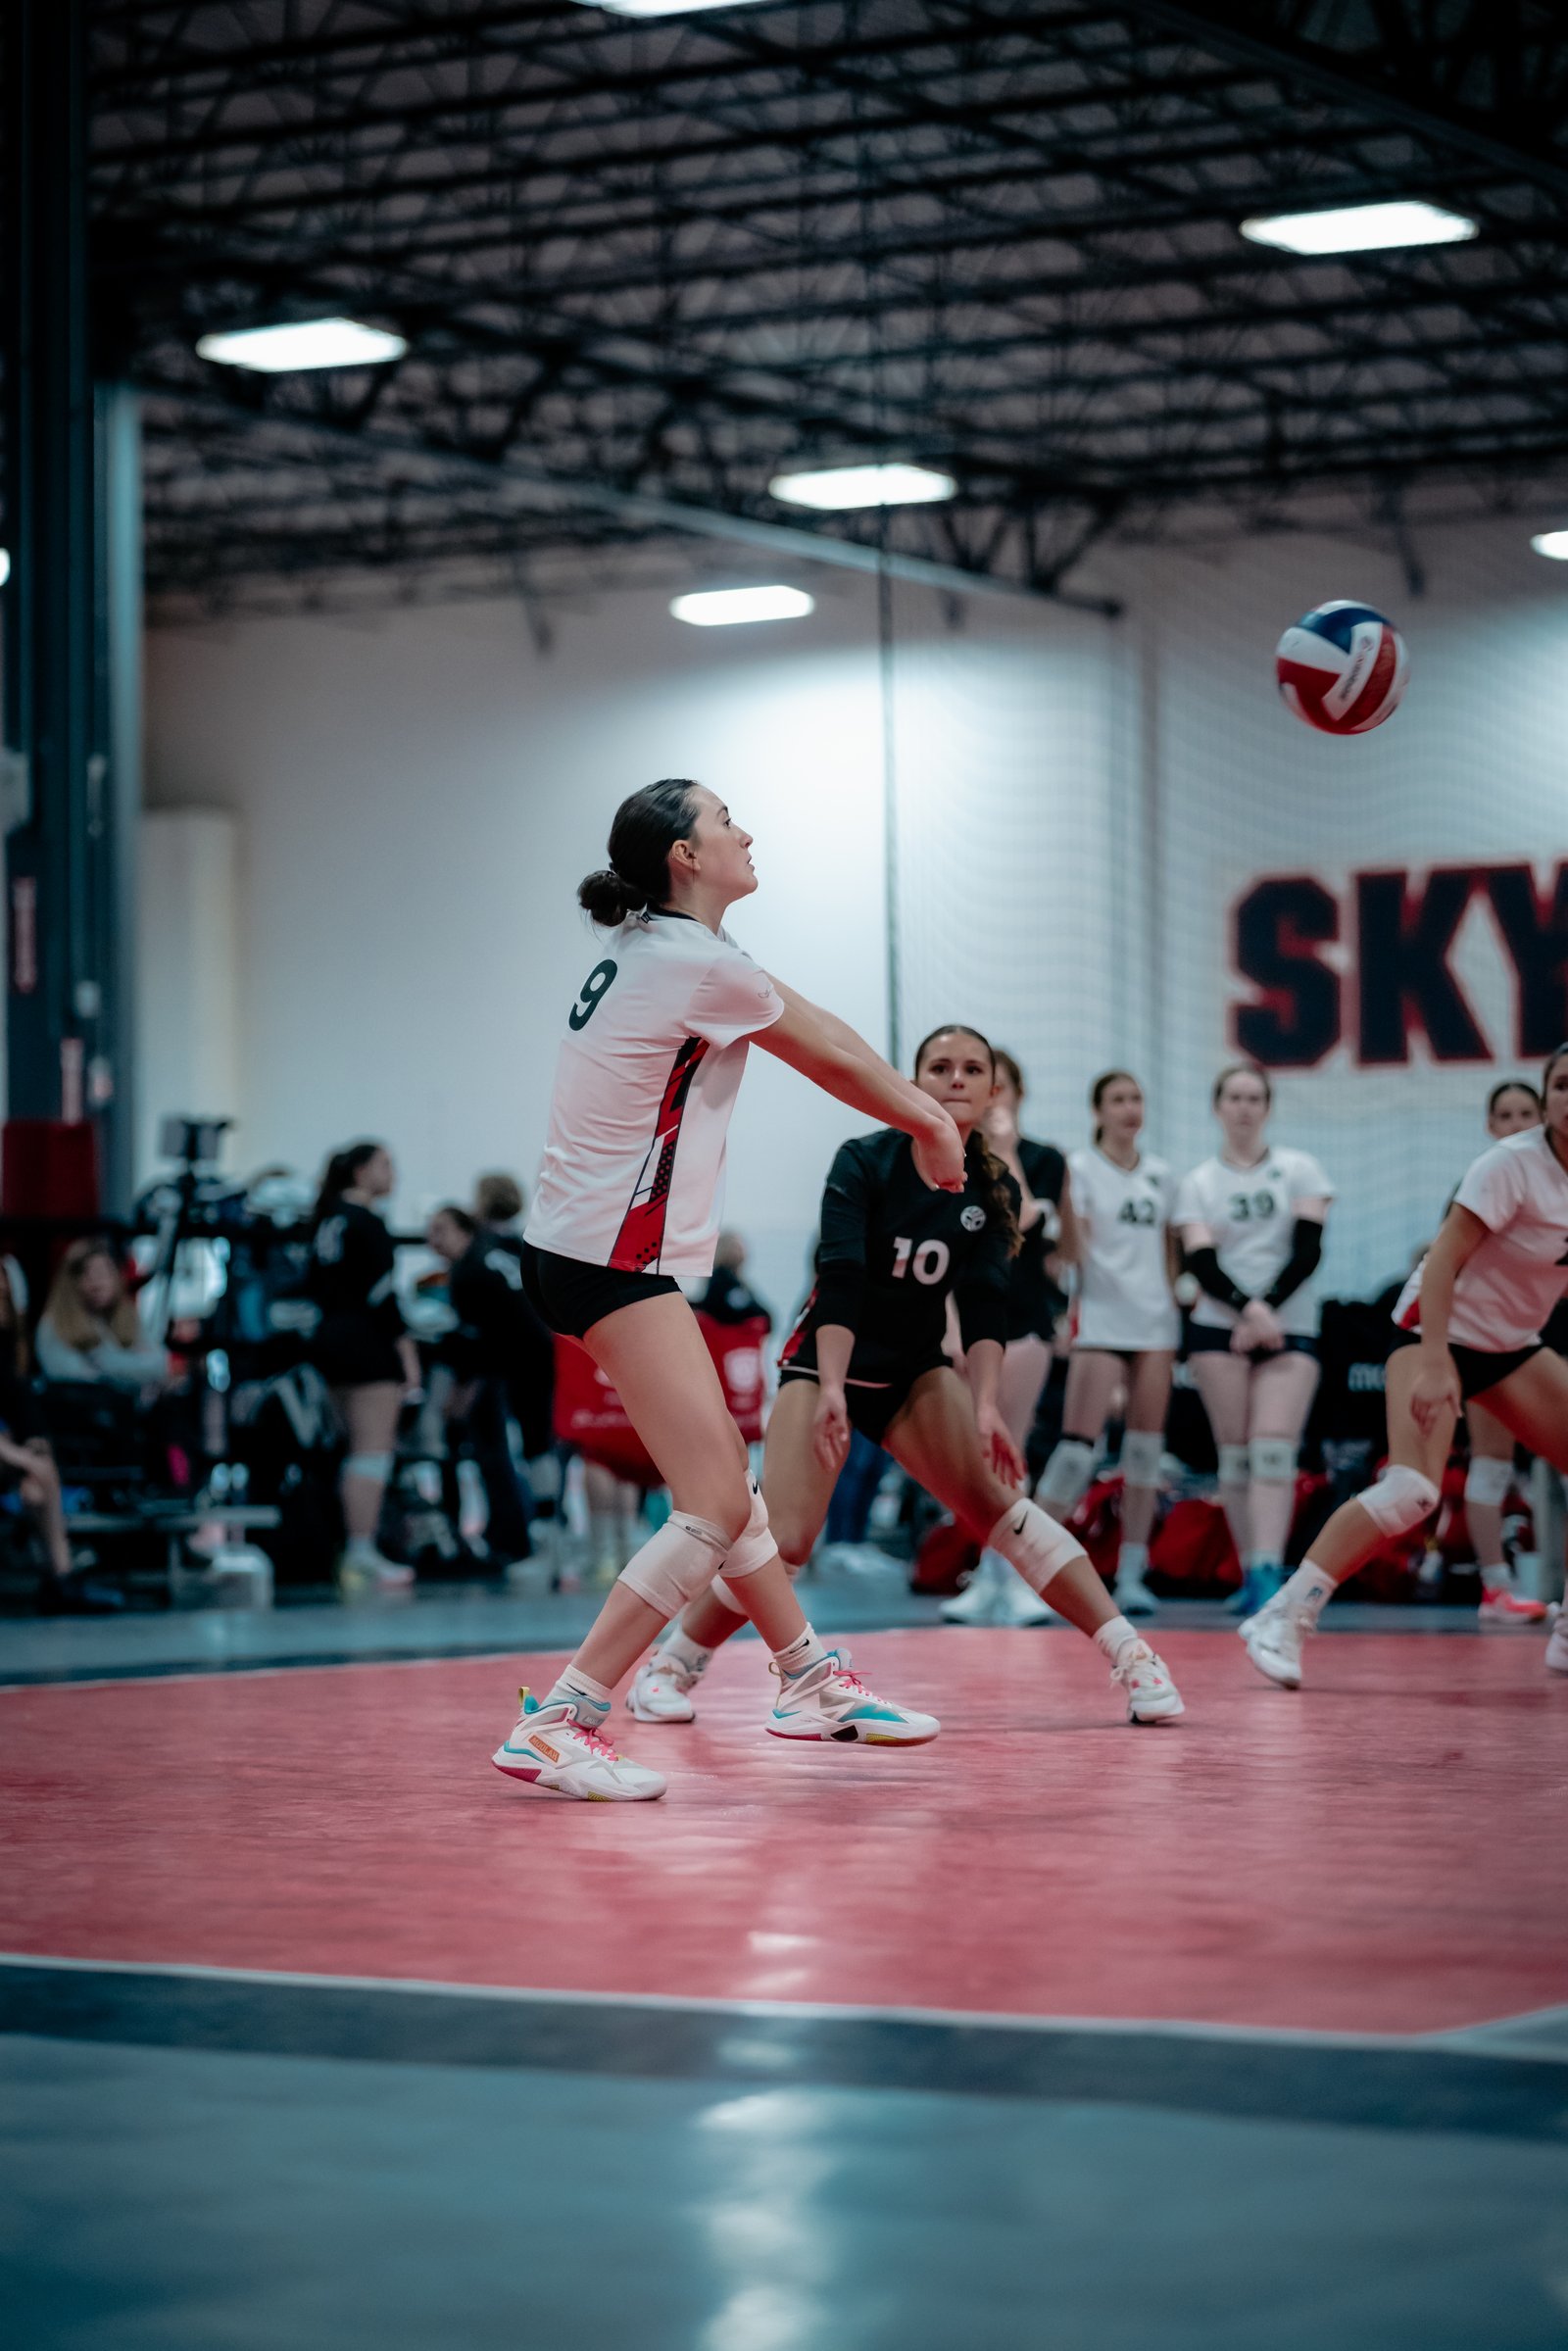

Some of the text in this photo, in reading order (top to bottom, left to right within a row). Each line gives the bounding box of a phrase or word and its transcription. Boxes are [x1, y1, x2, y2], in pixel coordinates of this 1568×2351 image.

[568, 958, 618, 1032] 9
[1118, 1197, 1156, 1225] 42
[1228, 1190, 1277, 1222] 39
[892, 1236, 951, 1286] 10
